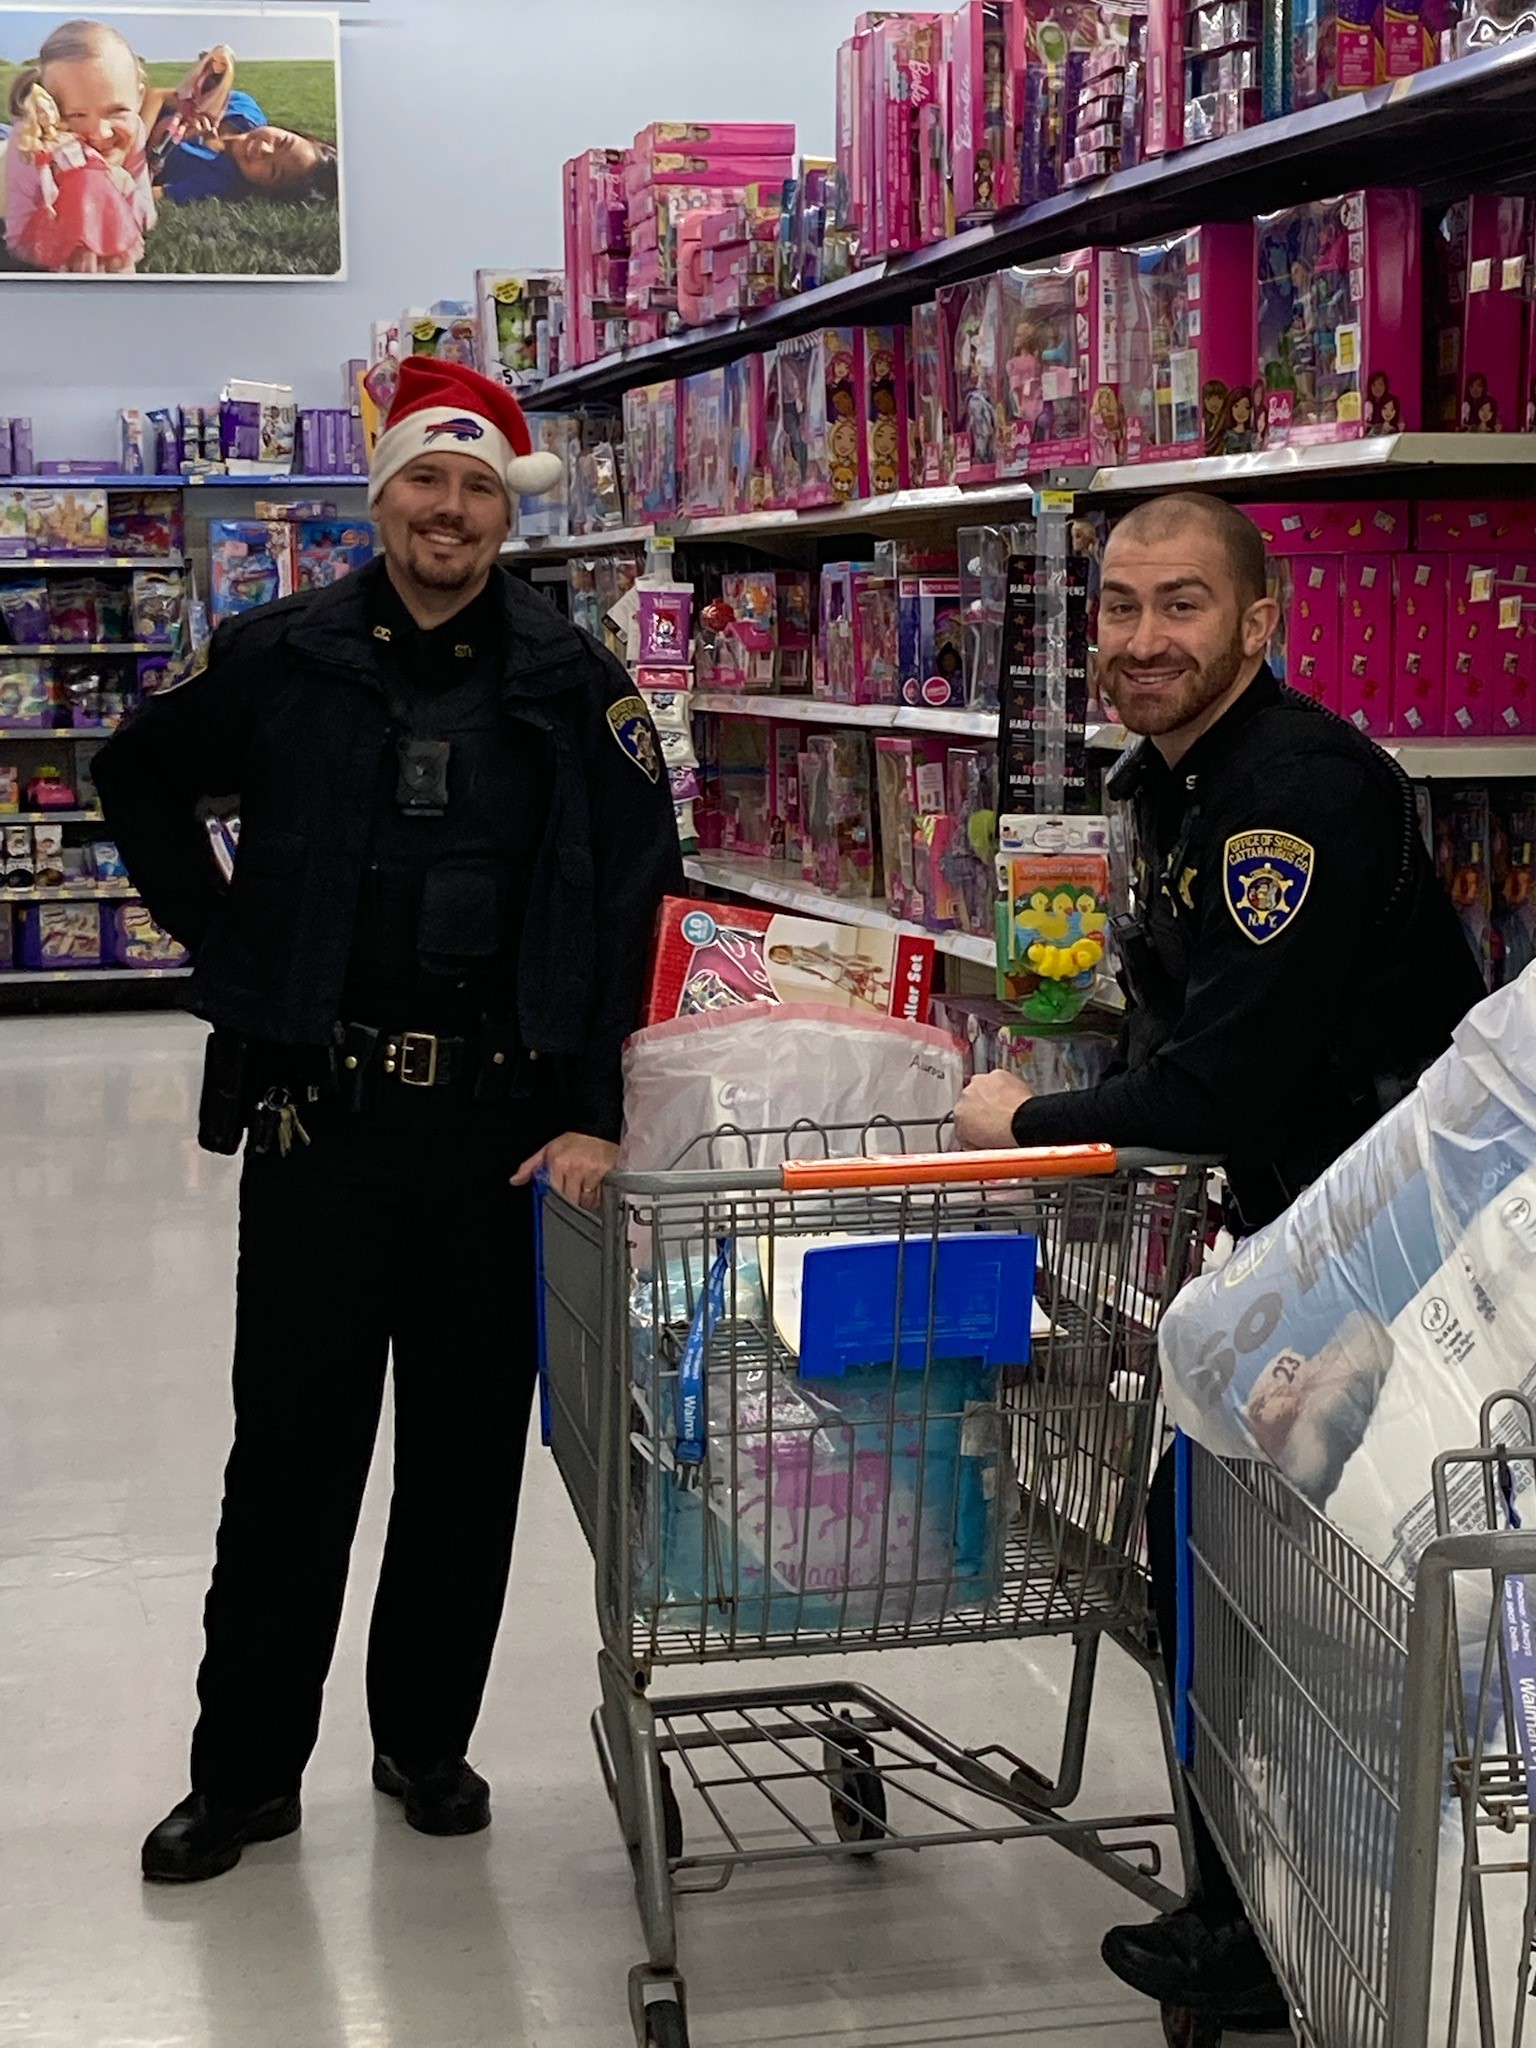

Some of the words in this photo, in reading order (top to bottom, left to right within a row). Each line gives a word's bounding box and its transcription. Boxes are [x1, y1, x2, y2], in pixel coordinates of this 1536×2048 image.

[502, 369, 514, 386] 5
[1228, 847, 1296, 865] CATTARAUGUS
[1229, 835, 1260, 853] OFFICE
[1260, 835, 1274, 846] OF
[1273, 836, 1311, 858] SHERIFF
[906, 953, 924, 983] Set
[1271, 1354, 1300, 1383] 23
